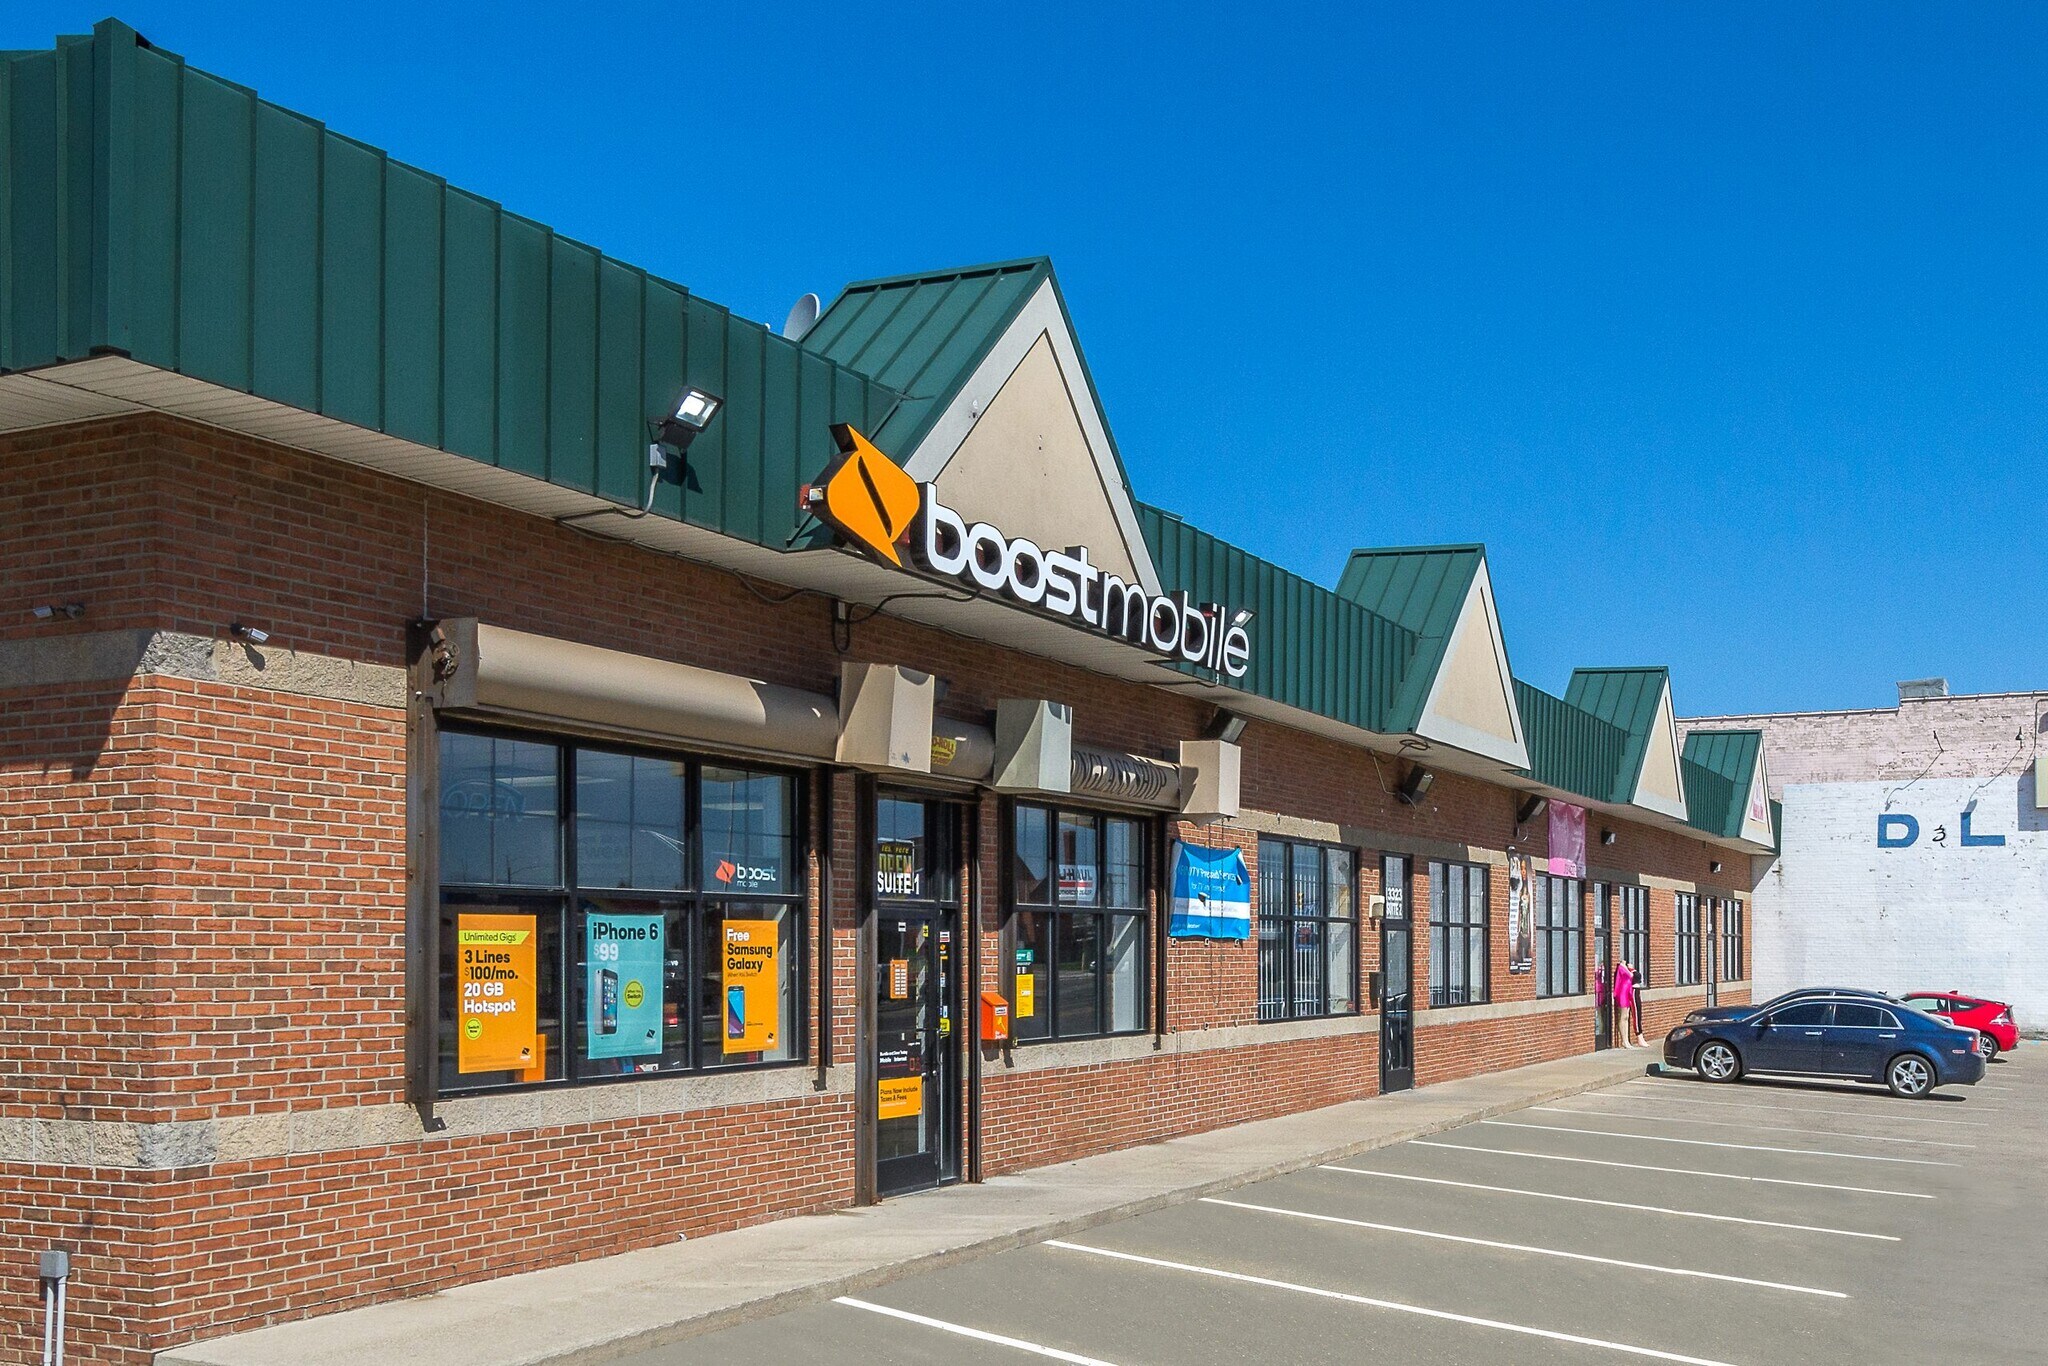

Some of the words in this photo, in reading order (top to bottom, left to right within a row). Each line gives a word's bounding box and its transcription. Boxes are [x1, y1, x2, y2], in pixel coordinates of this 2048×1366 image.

[1877, 813, 1920, 849] D
[1960, 811, 2006, 847] L
[736, 862, 777, 881] boost
[877, 870, 912, 895] SUITE
[913, 873, 920, 895] 1
[464, 932, 499, 942] Unlimited
[499, 932, 516, 944] Gigs
[593, 922, 646, 940] iPhone
[649, 922, 659, 941] 6
[726, 928, 750, 942] Free
[464, 950, 473, 963] 3
[475, 950, 511, 963] Lines
[593, 942, 619, 961] $99
[727, 943, 773, 958] Samsung
[727, 958, 764, 972] Galaxy
[464, 966, 519, 980] $100/mo.
[464, 983, 481, 997] 20
[483, 982, 504, 996] GB
[464, 999, 516, 1016] Hotspot
